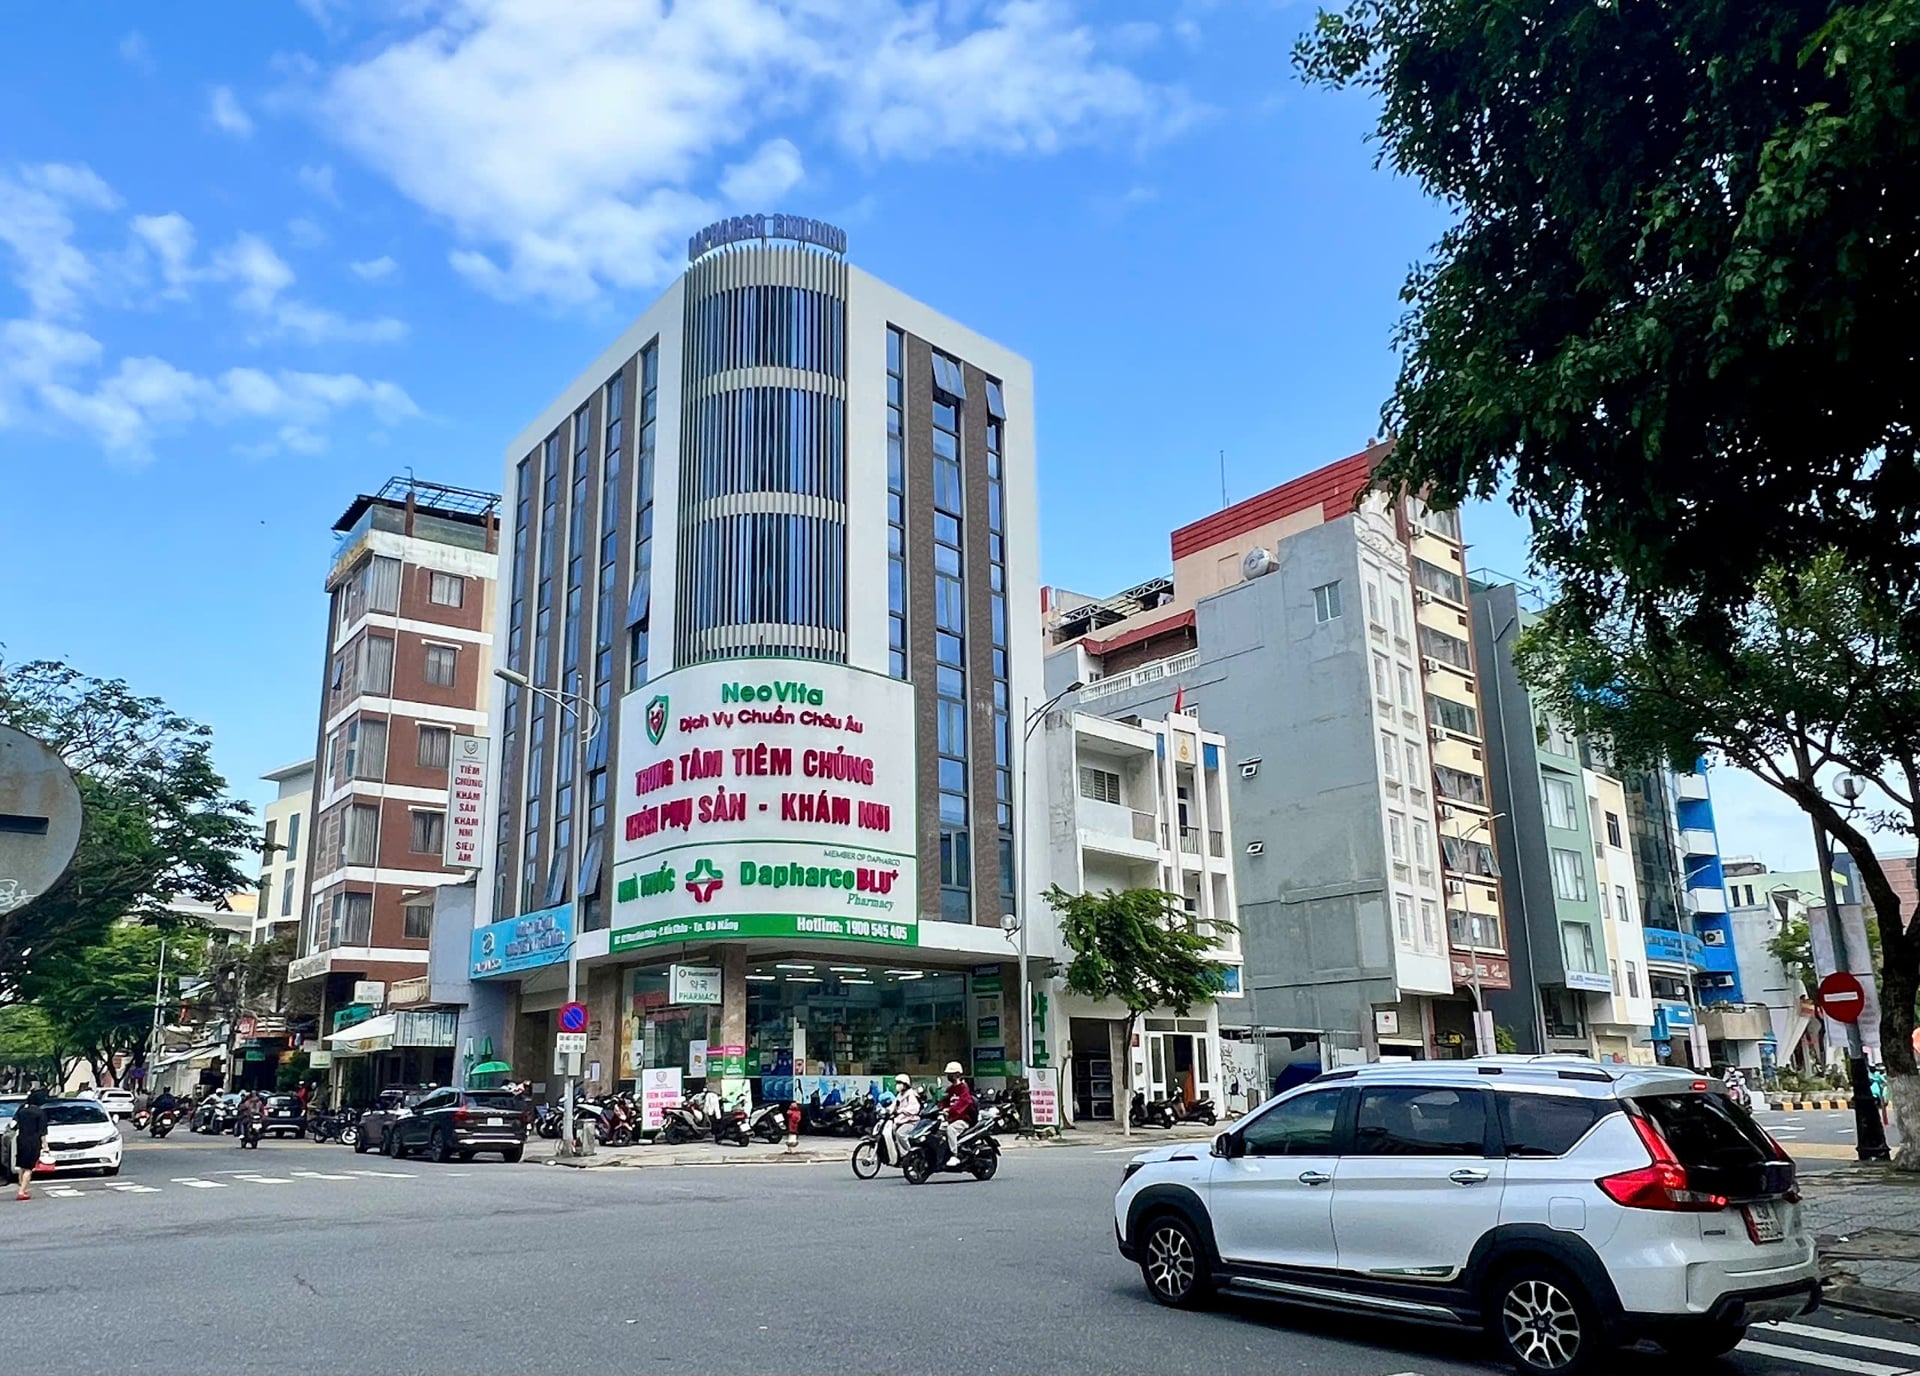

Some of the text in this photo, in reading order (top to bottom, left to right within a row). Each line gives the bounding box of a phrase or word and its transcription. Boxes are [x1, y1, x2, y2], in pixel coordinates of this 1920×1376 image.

[721, 681, 824, 706] NeoVita
[679, 705, 863, 734] Dịch Vụ Chuẩn Châu Âu
[635, 758, 674, 797] TRUNG
[679, 747, 723, 782] TÂM
[732, 743, 792, 776] TIÊM
[698, 785, 747, 823] SẢN
[781, 789, 851, 826] KHÁM
[858, 801, 890, 832] NHI
[824, 849, 900, 867] MEMBER OF DAPHARCO
[846, 892, 894, 912] Pharmacy
[797, 916, 907, 940] Hotline: 1900 545 405
[678, 991, 718, 1001] PHARMACY
